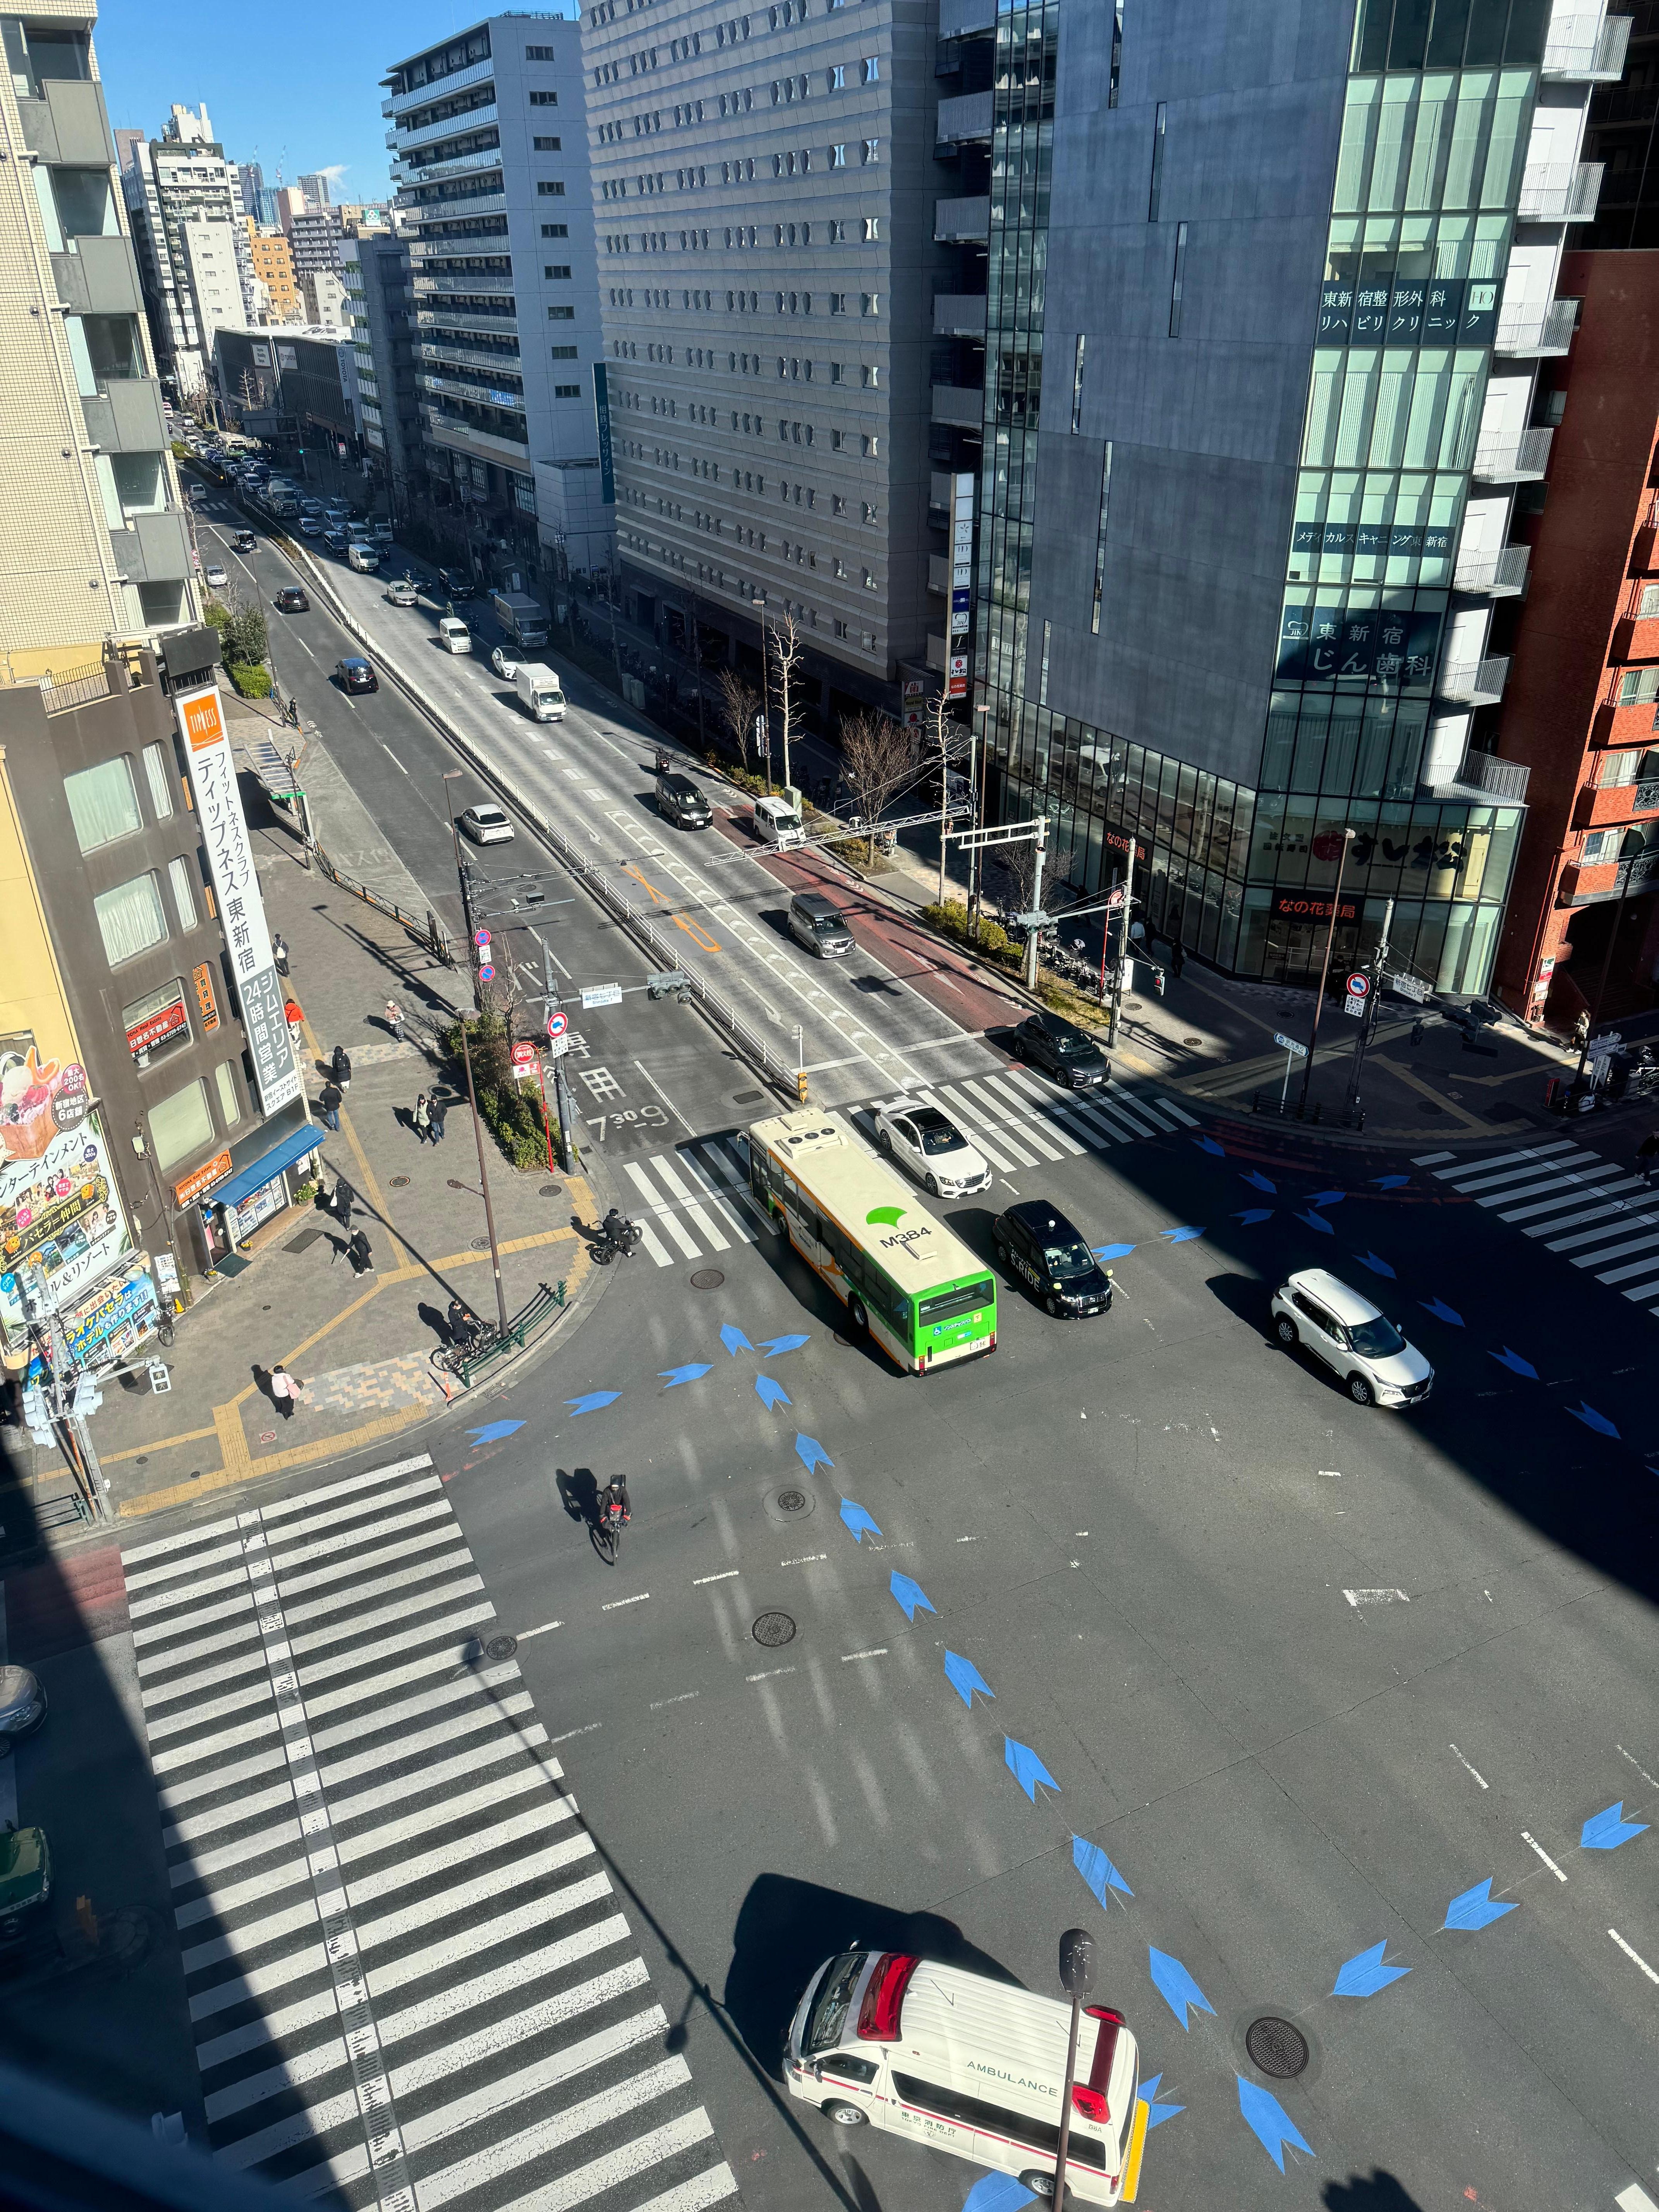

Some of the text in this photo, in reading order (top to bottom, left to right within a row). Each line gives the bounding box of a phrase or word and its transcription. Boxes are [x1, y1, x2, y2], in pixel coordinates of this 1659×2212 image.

[1322, 290, 1446, 307] 東新宿整形外科
[1321, 314, 1480, 331] リハビリクリニック
[1297, 532, 1448, 548] メディカルスキャニング東新宿
[1316, 622, 1403, 644] 東新宿
[1314, 648, 1431, 677] じん歯科
[190, 705, 218, 737] TIPNESS
[215, 752, 249, 888] フィットネスクラブ
[1279, 898, 1355, 919] なの花薬局
[1395, 978, 1423, 996] 新宿七丁目
[261, 971, 289, 1068] ジムエリア
[243, 979, 278, 1085] 24時間営業
[516, 1049, 532, 1058] 消火栓
[64, 1073, 84, 1086] 200名
[68, 1081, 81, 1092] OK!
[55, 1094, 85, 1111] 新宿地区
[266, 1083, 299, 1111] スクエア B1F
[58, 1105, 83, 1121] 6店舗
[879, 1227, 933, 1249] M384
[1011, 1253, 1039, 1292] S.RIDE
[63, 1289, 132, 1346] ラオケパセラは
[967, 2061, 1058, 2097] AMBULANCE
[901, 2117, 921, 2126] TOKYO
[902, 2111, 956, 2134] 東京消防庁
